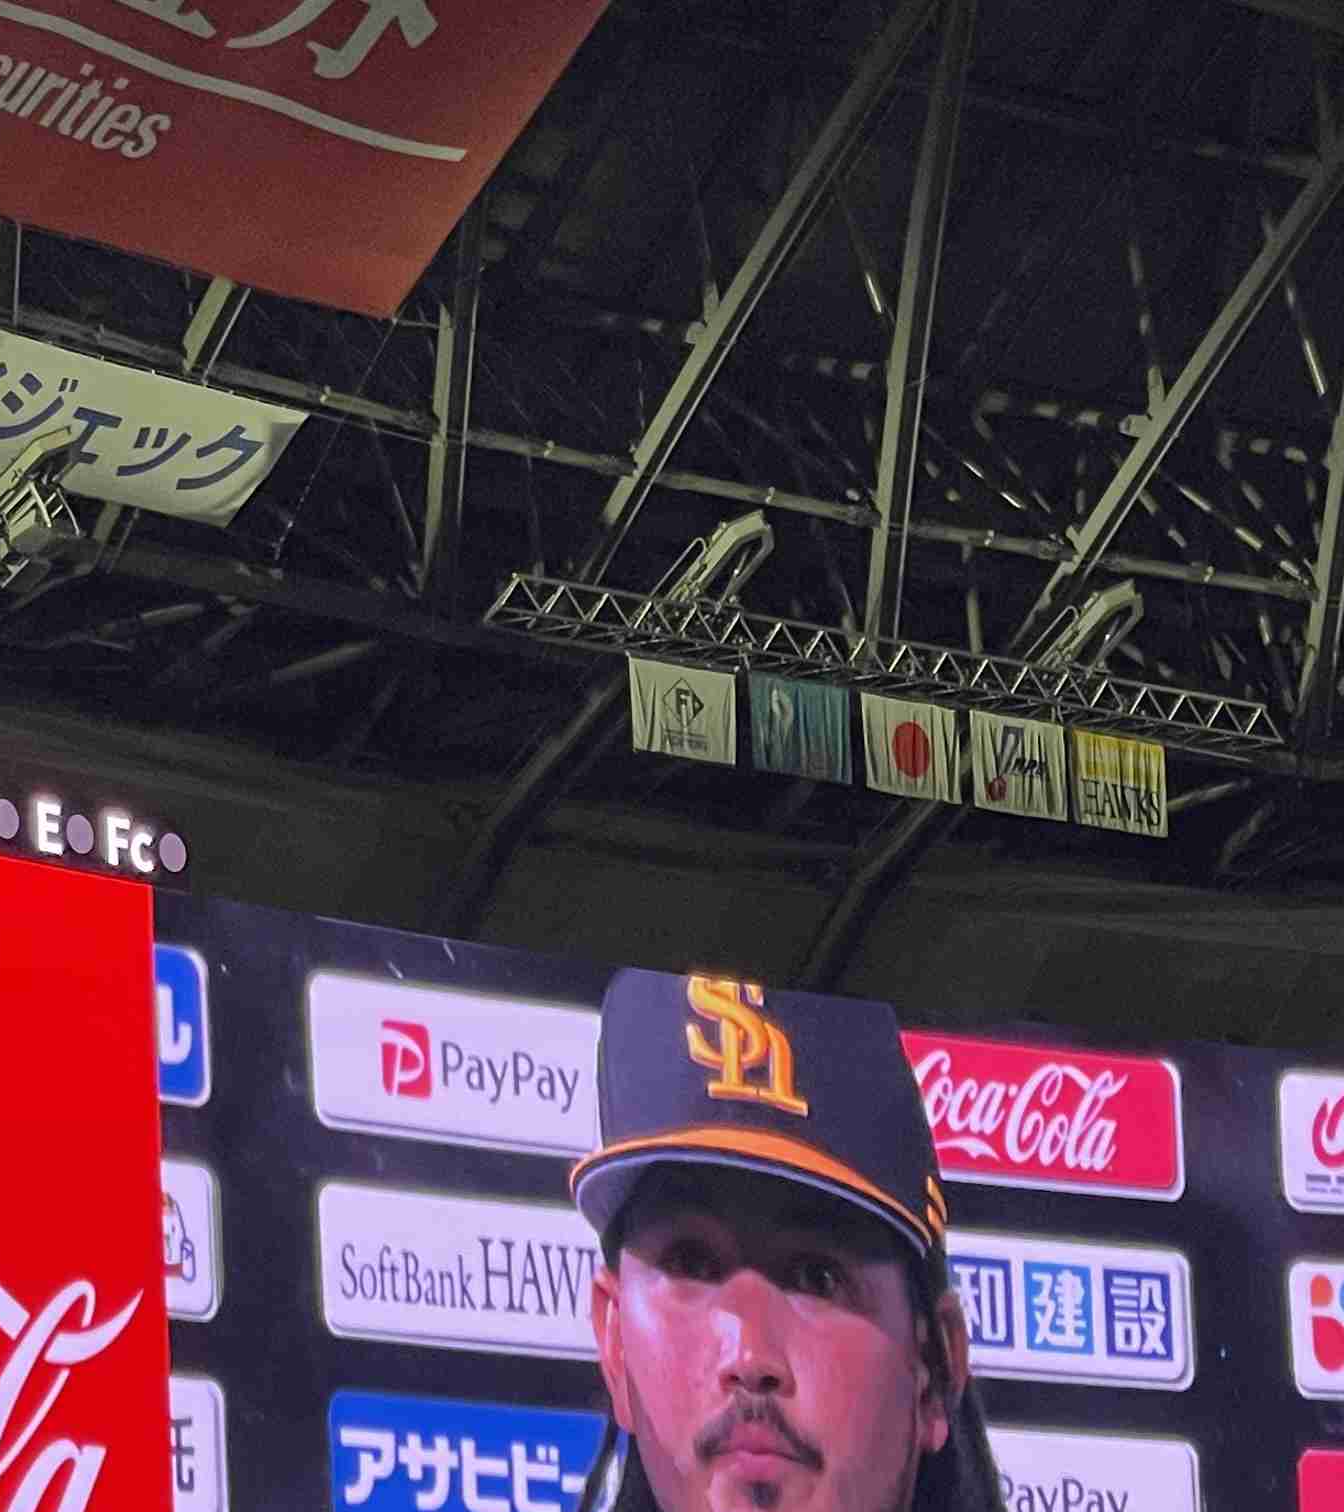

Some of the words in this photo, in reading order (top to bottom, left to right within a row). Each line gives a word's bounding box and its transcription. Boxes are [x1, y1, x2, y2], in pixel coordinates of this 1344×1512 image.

[36, 801, 64, 855] E
[441, 1042, 579, 1113] PayPay
[341, 1243, 474, 1311] SoftBank
